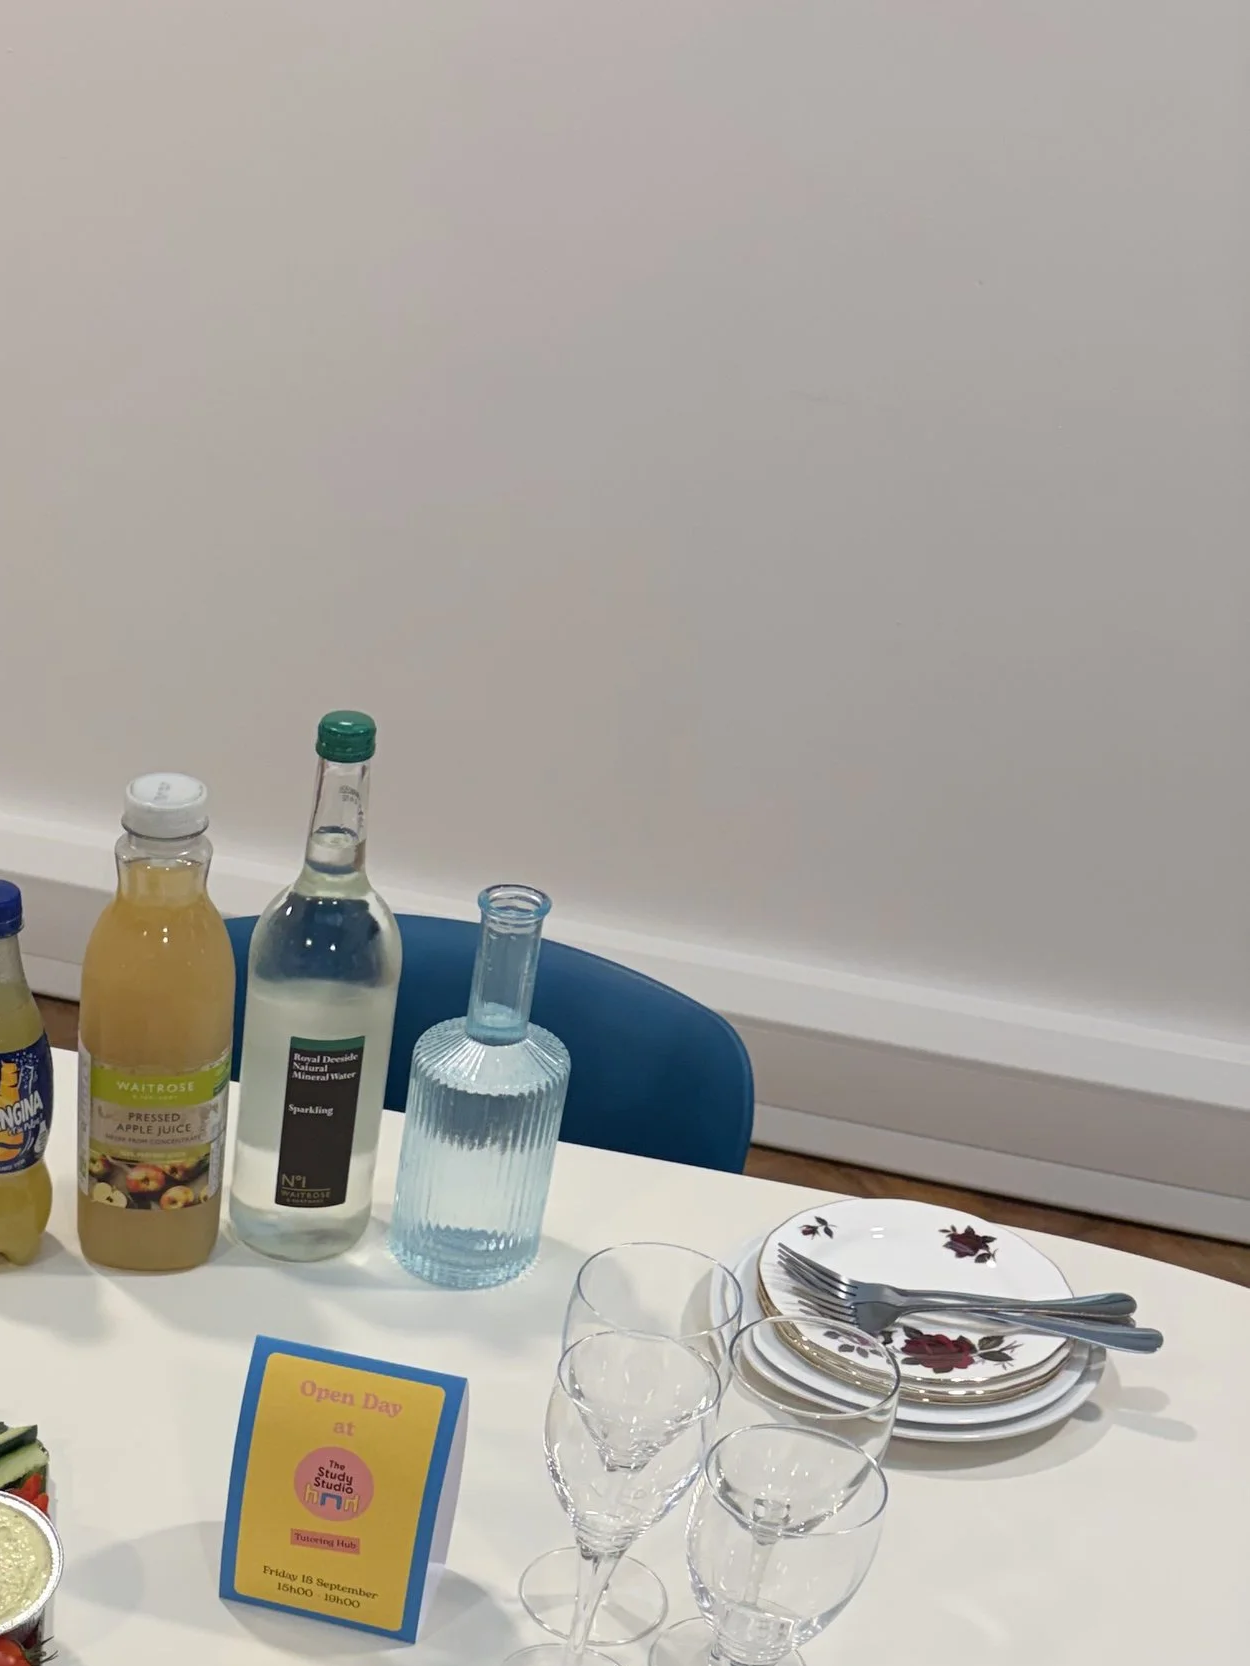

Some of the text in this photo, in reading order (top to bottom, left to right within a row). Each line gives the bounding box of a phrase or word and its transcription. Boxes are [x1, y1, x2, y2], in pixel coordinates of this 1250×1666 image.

[293, 1053, 359, 1064] Royal Deeside
[293, 1061, 328, 1072] Natural
[292, 1070, 357, 1081] Mineral Water
[116, 1081, 195, 1094] WAITROSE
[288, 1103, 334, 1116] Sparkling
[128, 1111, 181, 1123] PRESSED
[116, 1123, 192, 1137] APPLE JUICE
[281, 1189, 331, 1199] WAITROSE
[300, 1380, 403, 1418] Open Day
[333, 1421, 355, 1437] at
[329, 1460, 346, 1471] The
[317, 1466, 354, 1486] Study
[313, 1477, 354, 1495] Studio
[294, 1533, 357, 1549] Tutoring Hub
[263, 1565, 299, 1583] Friday
[316, 1578, 379, 1600] September
[277, 1582, 361, 1609] 15h00 19h00
